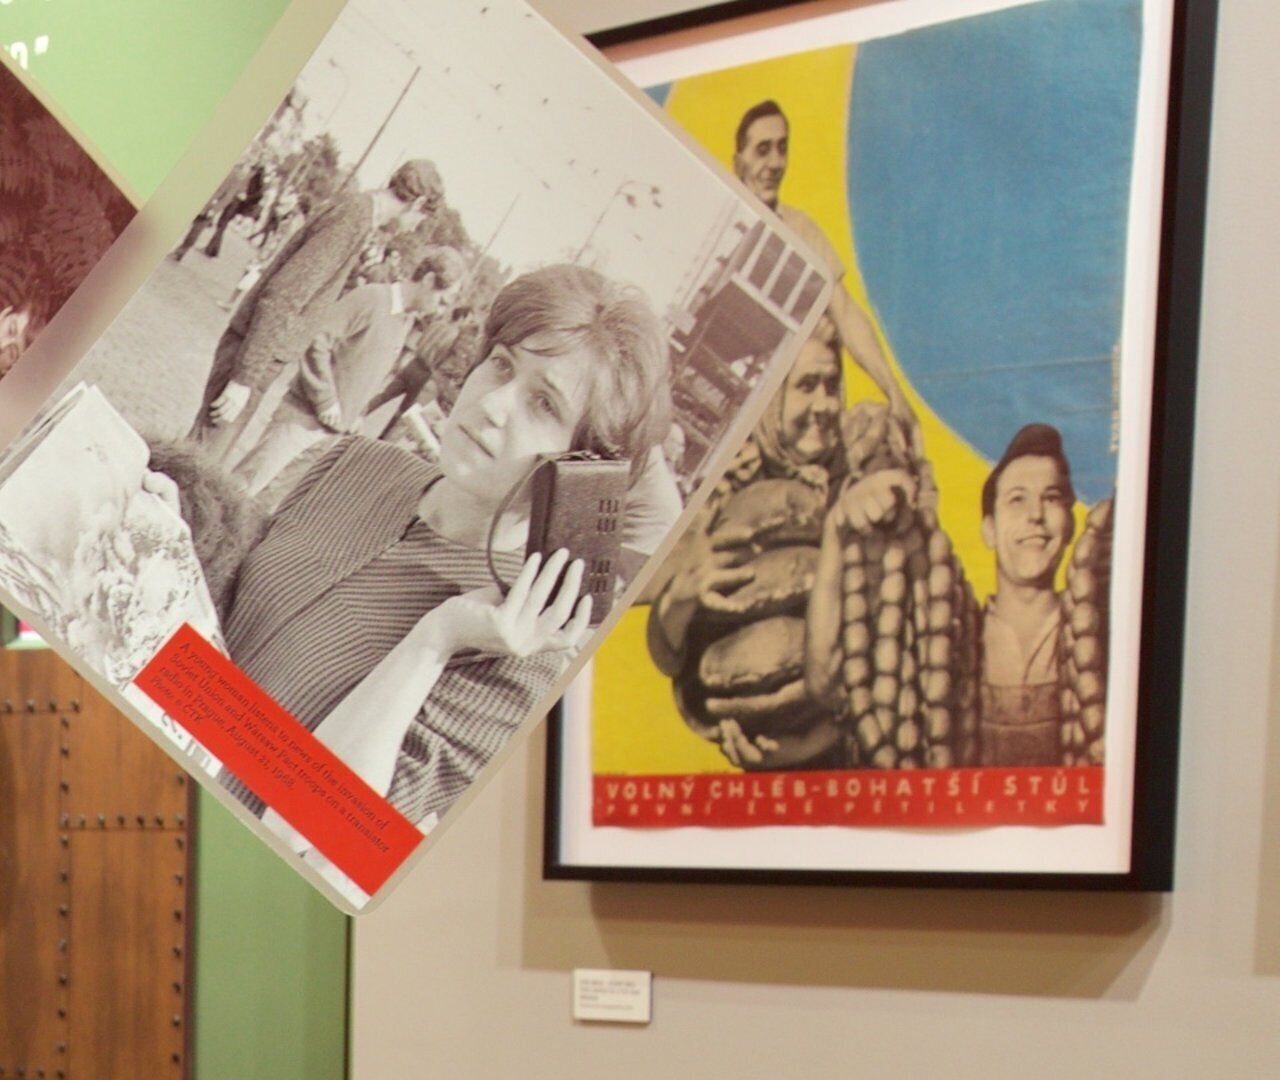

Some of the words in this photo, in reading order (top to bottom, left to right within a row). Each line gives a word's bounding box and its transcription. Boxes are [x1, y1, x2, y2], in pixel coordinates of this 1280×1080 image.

[187, 651, 217, 678] young
[216, 675, 249, 706] woman
[321, 767, 340, 786] the
[198, 677, 227, 705] Union
[224, 701, 245, 721] and
[605, 775, 696, 800] VOLNÝ
